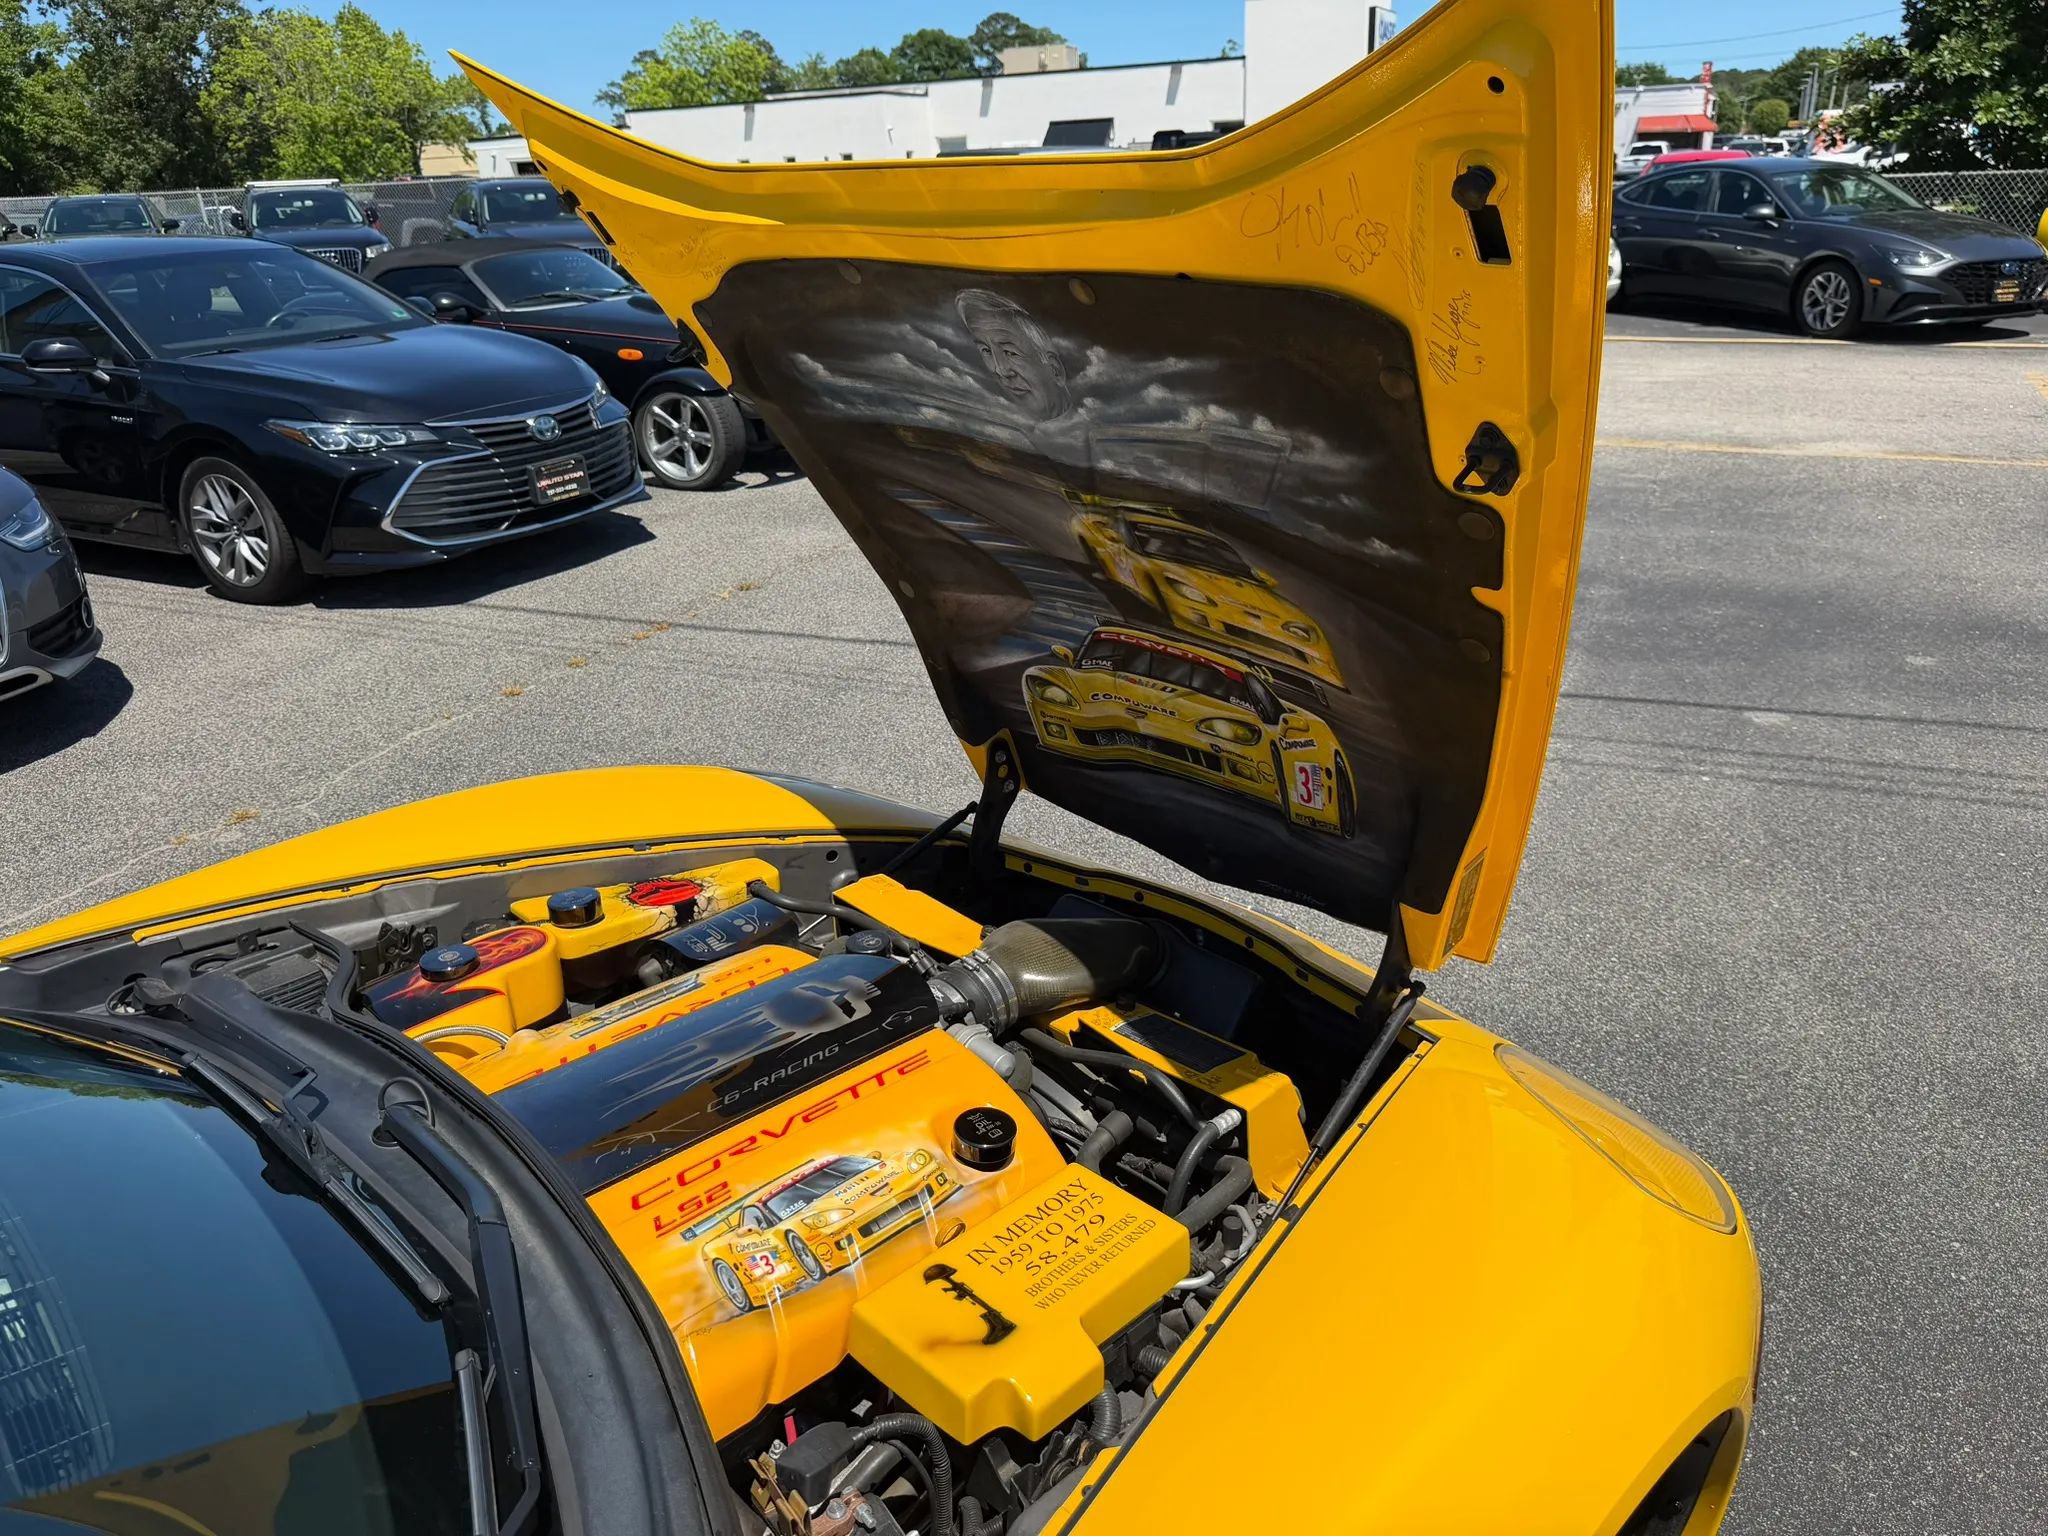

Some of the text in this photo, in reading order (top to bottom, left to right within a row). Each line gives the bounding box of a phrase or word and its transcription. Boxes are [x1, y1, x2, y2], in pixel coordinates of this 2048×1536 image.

[1090, 693, 1178, 717] COMPUWARE
[1298, 766, 1313, 804] 3
[706, 1044, 840, 1113] C6-RACING
[631, 1049, 931, 1211] CORVETTE
[975, 1120, 992, 1129] OIL
[653, 1180, 732, 1233] LS2
[966, 1177, 1089, 1266] IN MEMORY
[990, 1192, 1104, 1275] 1959 TO 1975
[759, 1254, 776, 1275] 3
[1024, 1212, 1138, 1299] BROTHERS & SISTERS
[1034, 1219, 1157, 1311] WHO NEVER RETURNED
